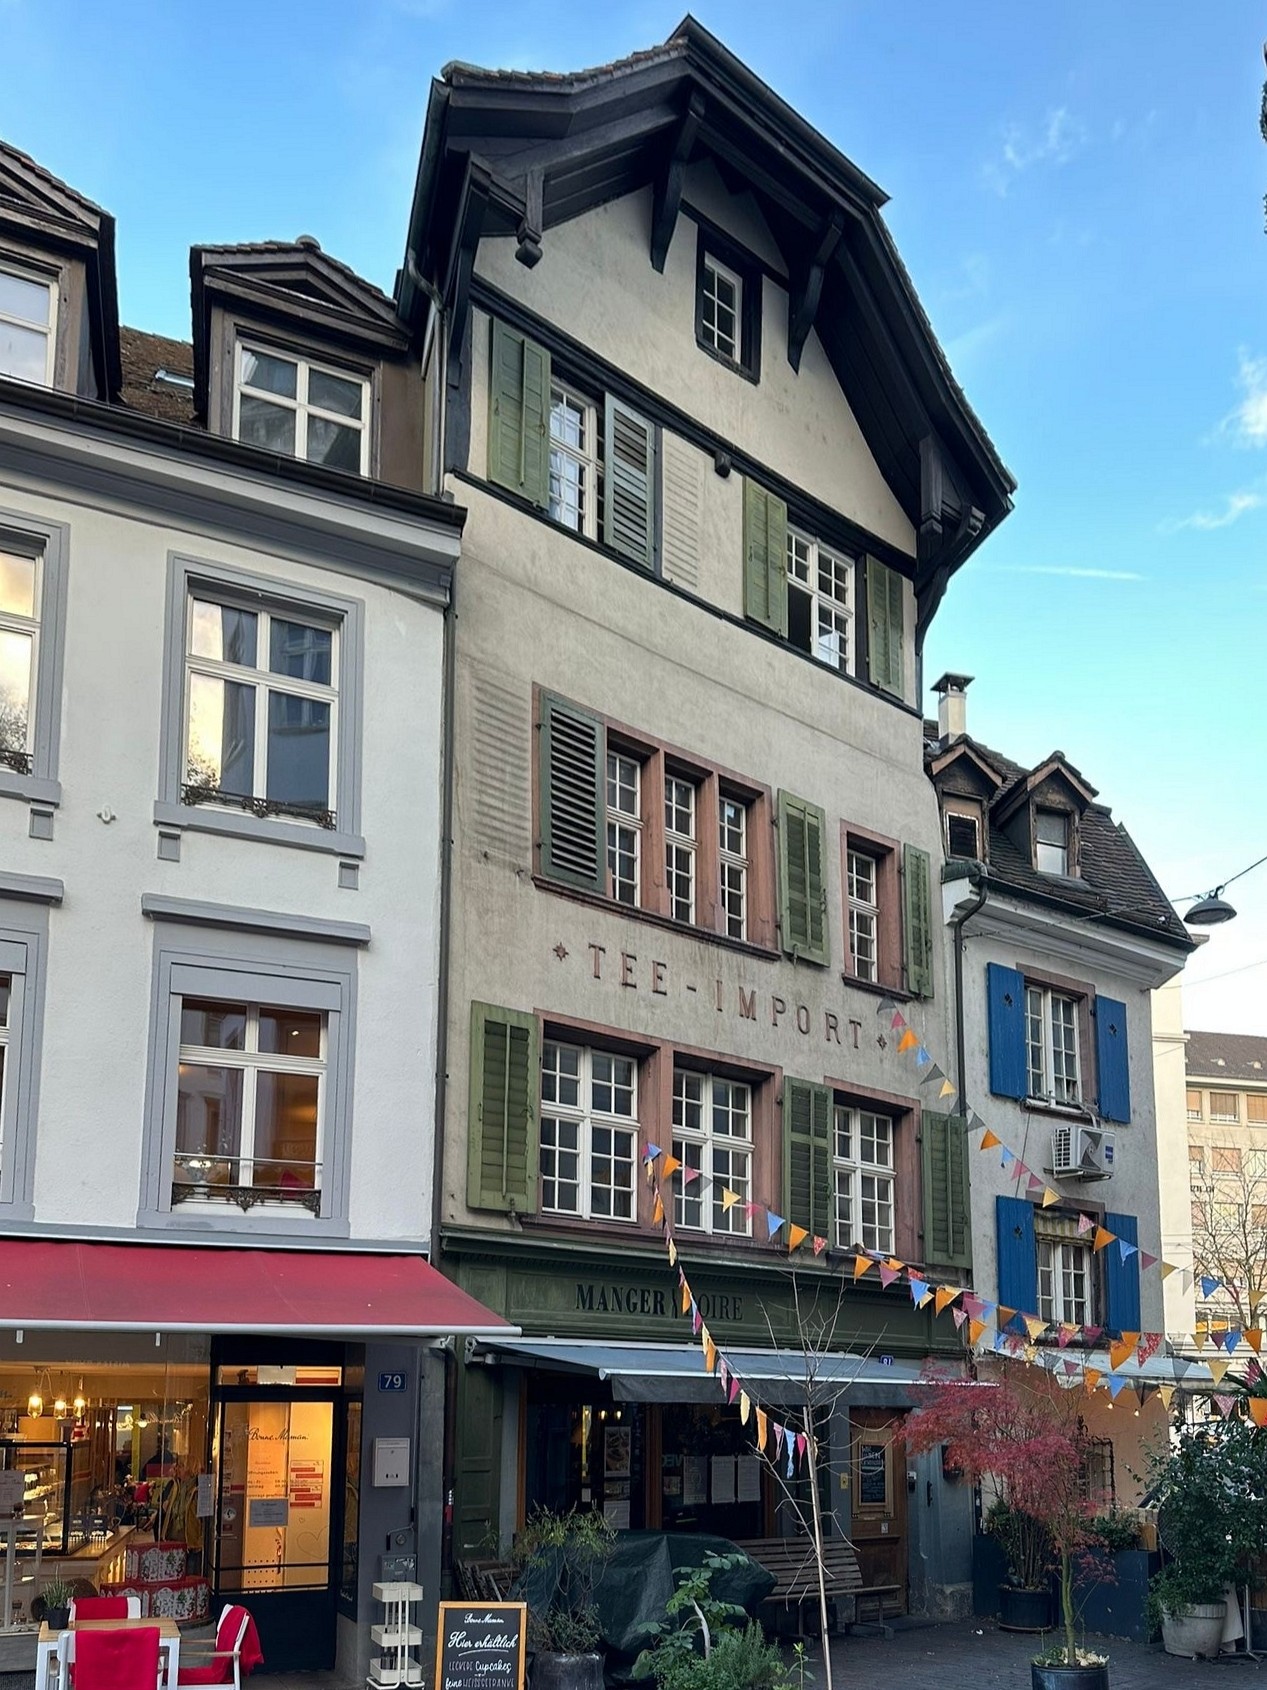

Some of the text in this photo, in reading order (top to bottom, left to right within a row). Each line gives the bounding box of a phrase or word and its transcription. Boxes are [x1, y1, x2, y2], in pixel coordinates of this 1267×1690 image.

[576, 1283, 665, 1315] MANGER
[384, 1375, 402, 1388] 79
[447, 1631, 519, 1648] Hier erhältlich
[475, 1659, 512, 1676] Cupcakes
